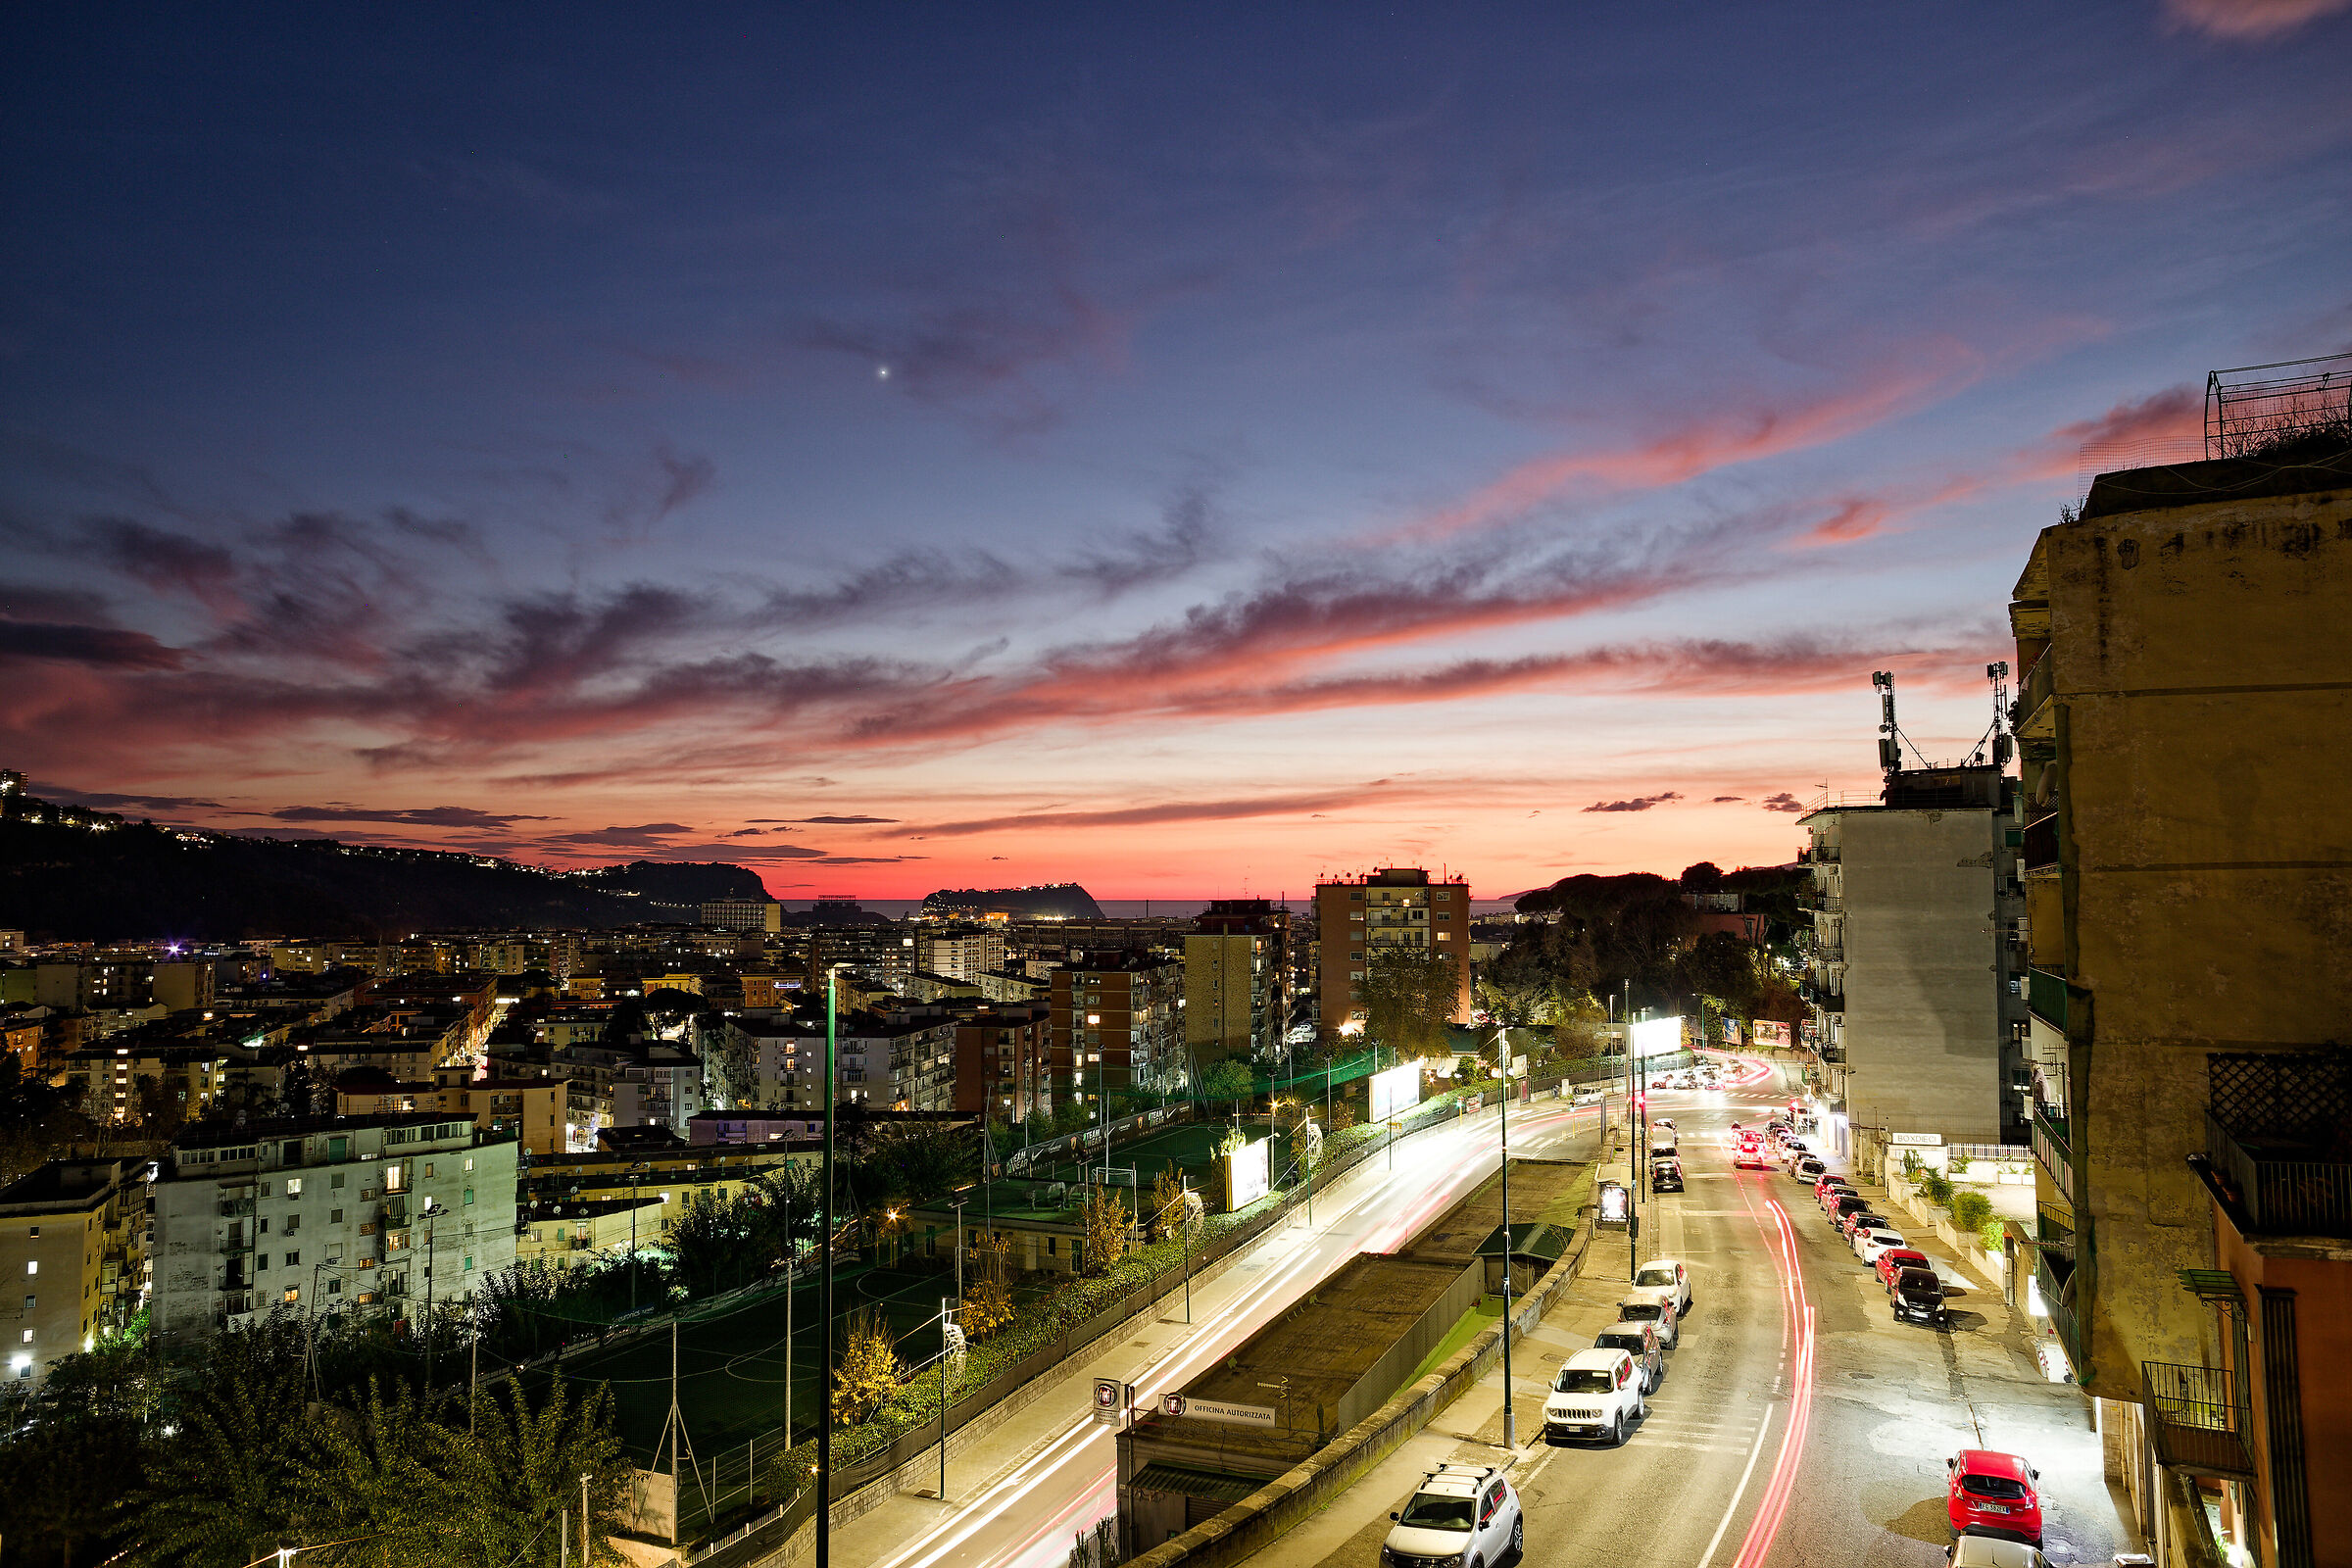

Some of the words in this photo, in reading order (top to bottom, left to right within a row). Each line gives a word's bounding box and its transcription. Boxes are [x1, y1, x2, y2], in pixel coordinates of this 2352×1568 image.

[1086, 1128, 1101, 1140] TEAM
[1195, 1405, 1225, 1415] OFFICINA
[1226, 1408, 1272, 1420] AUTORIZZATA
